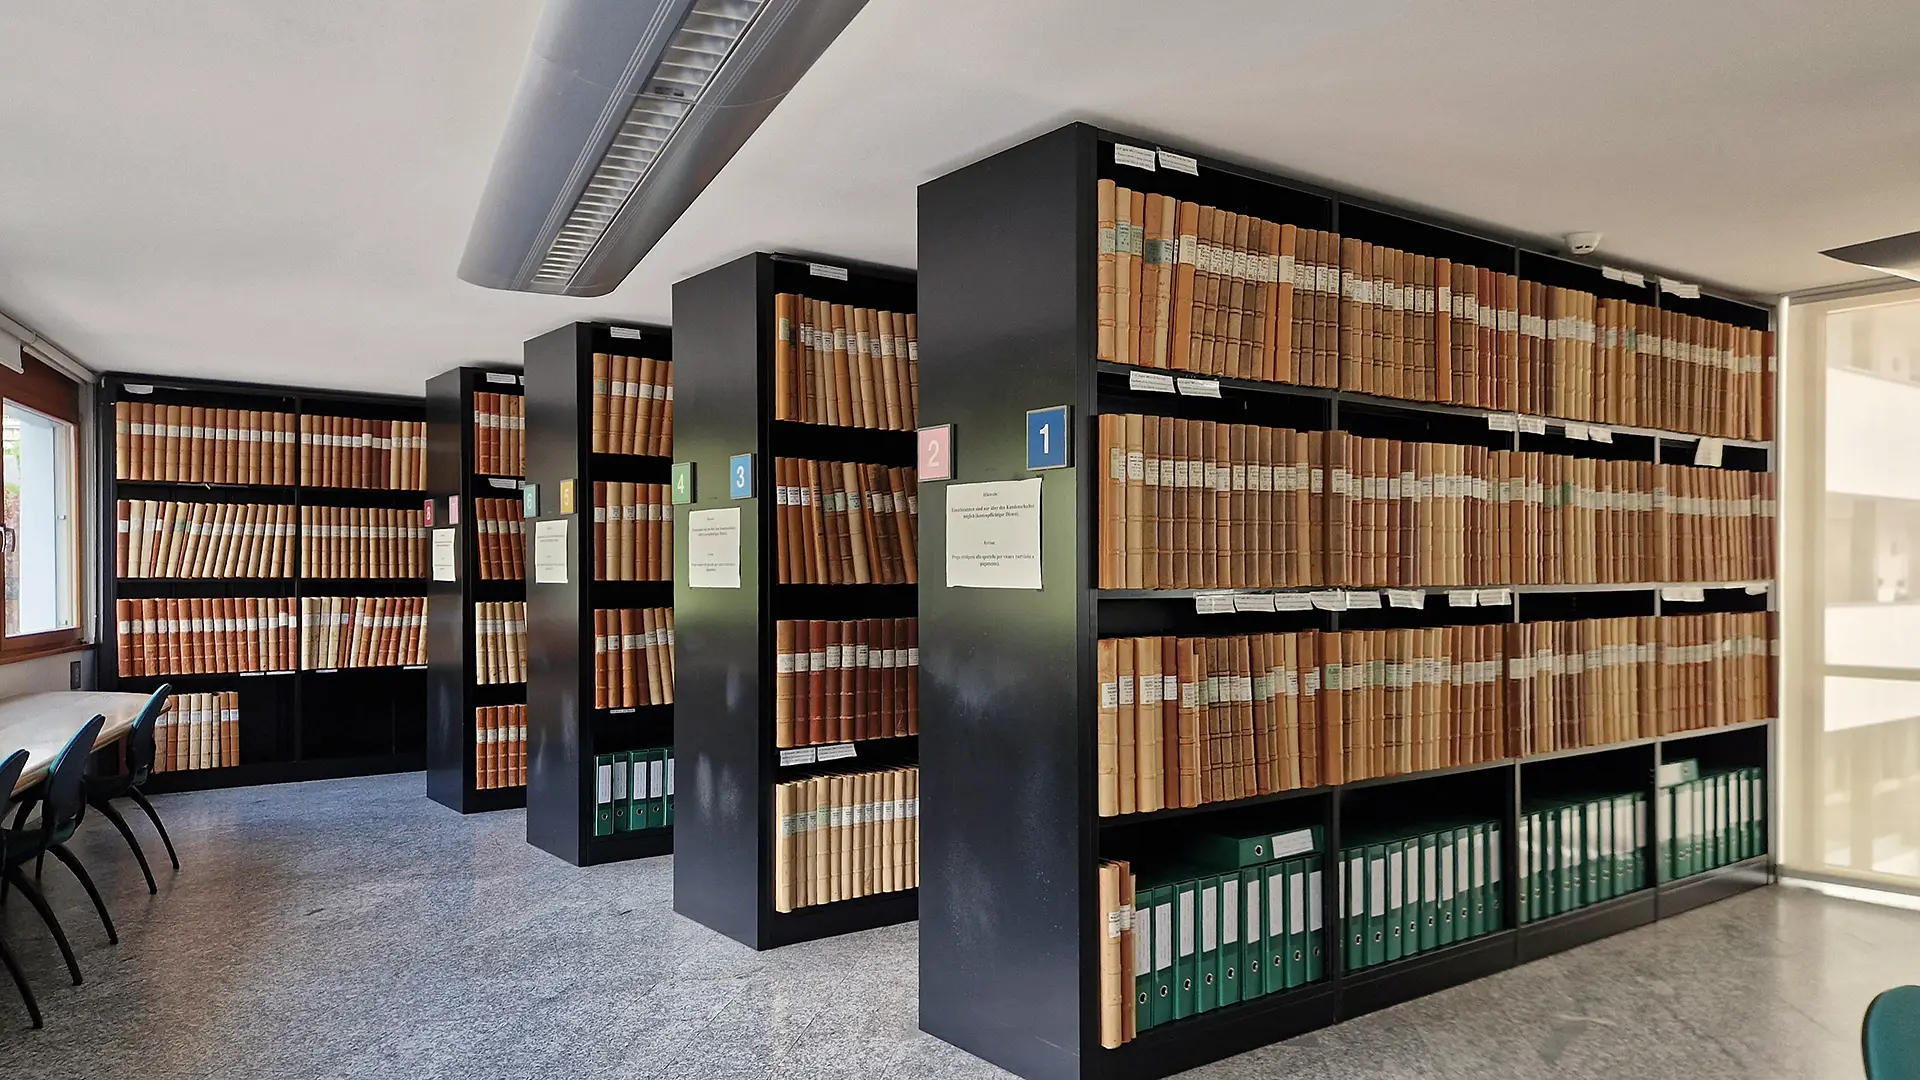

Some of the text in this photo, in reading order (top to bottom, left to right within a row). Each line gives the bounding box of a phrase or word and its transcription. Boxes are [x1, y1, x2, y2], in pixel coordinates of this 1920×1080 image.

[1039, 423, 1050, 455] 1
[927, 439, 941, 468] 2
[677, 473, 685, 494] 4
[736, 465, 745, 489] 3
[526, 492, 532, 510] 6
[564, 488, 569, 506] 5
[426, 505, 431, 521] 8
